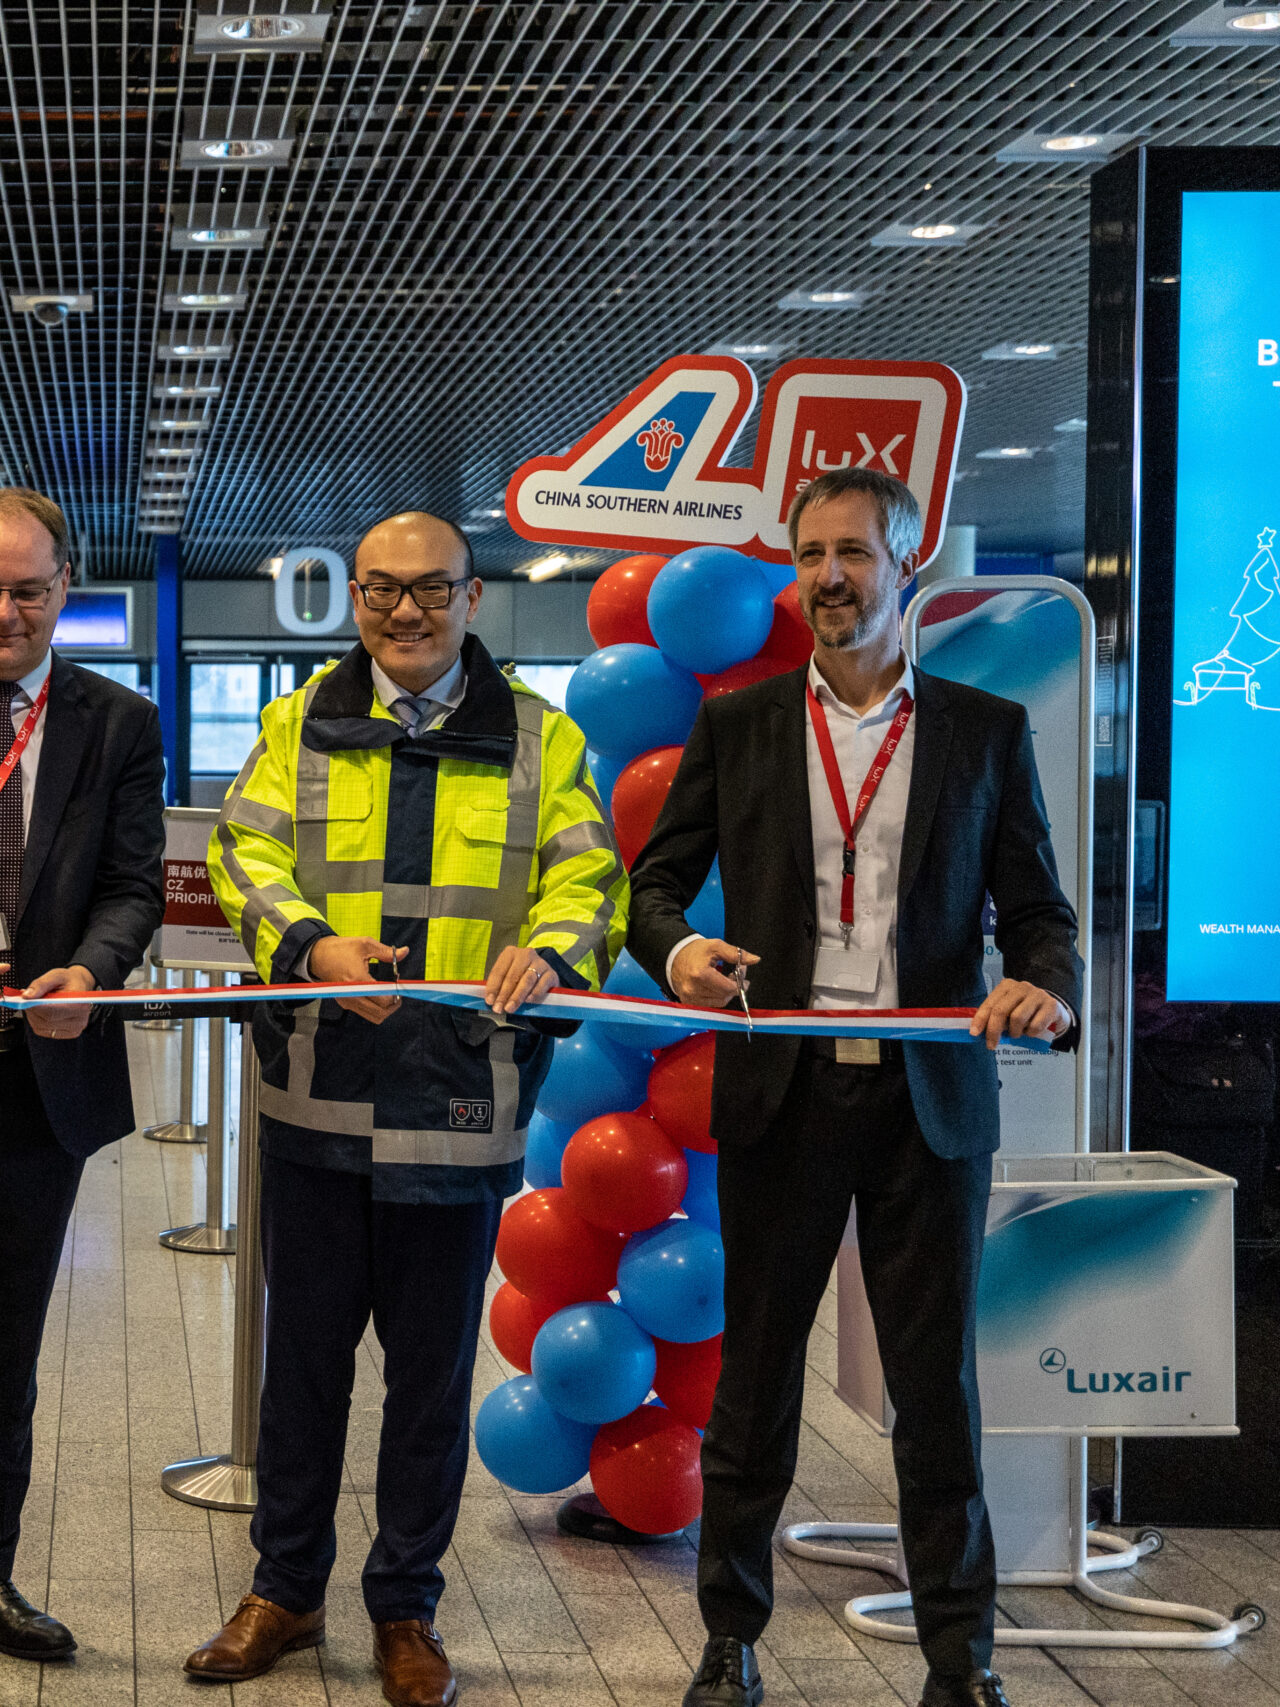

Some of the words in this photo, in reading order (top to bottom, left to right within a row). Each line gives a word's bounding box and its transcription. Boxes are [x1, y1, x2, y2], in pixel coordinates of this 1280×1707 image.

[535, 490, 581, 508] CHINA
[586, 494, 669, 515] SOUTHERN
[673, 501, 743, 521] AIRLINES
[167, 865, 209, 879] 南航优
[166, 879, 185, 891] CZ
[166, 892, 217, 905] PRIORIT
[1199, 924, 1244, 934] WEALTH
[1067, 1366, 1192, 1393] Luxair
